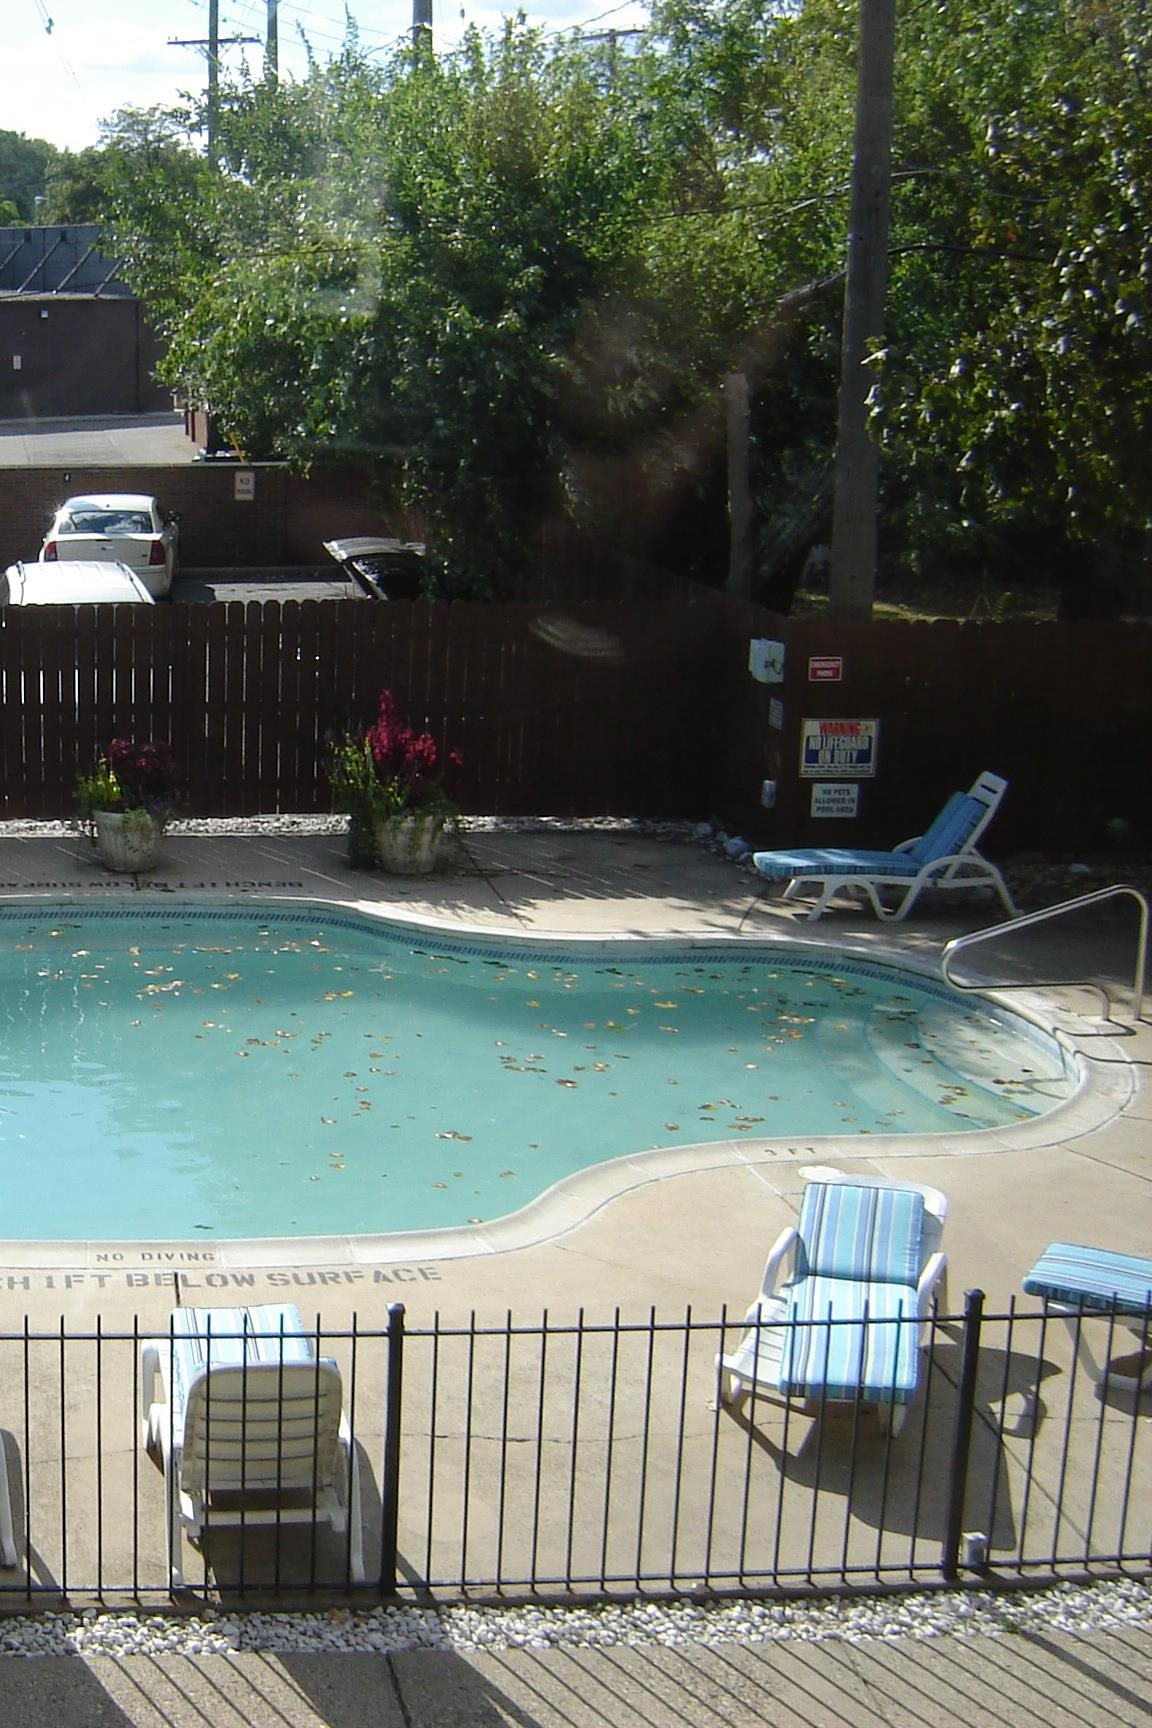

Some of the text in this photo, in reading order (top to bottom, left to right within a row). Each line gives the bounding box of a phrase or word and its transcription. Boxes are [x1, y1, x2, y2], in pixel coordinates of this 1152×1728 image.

[819, 721, 860, 735] WARNING
[808, 735, 869, 750] NO LIFEGUARD
[818, 749, 857, 763] ON DUTY
[96, 1252, 215, 1262] NO DIVING
[126, 1271, 256, 1288] BELOW
[266, 1266, 443, 1287] SURFACE
